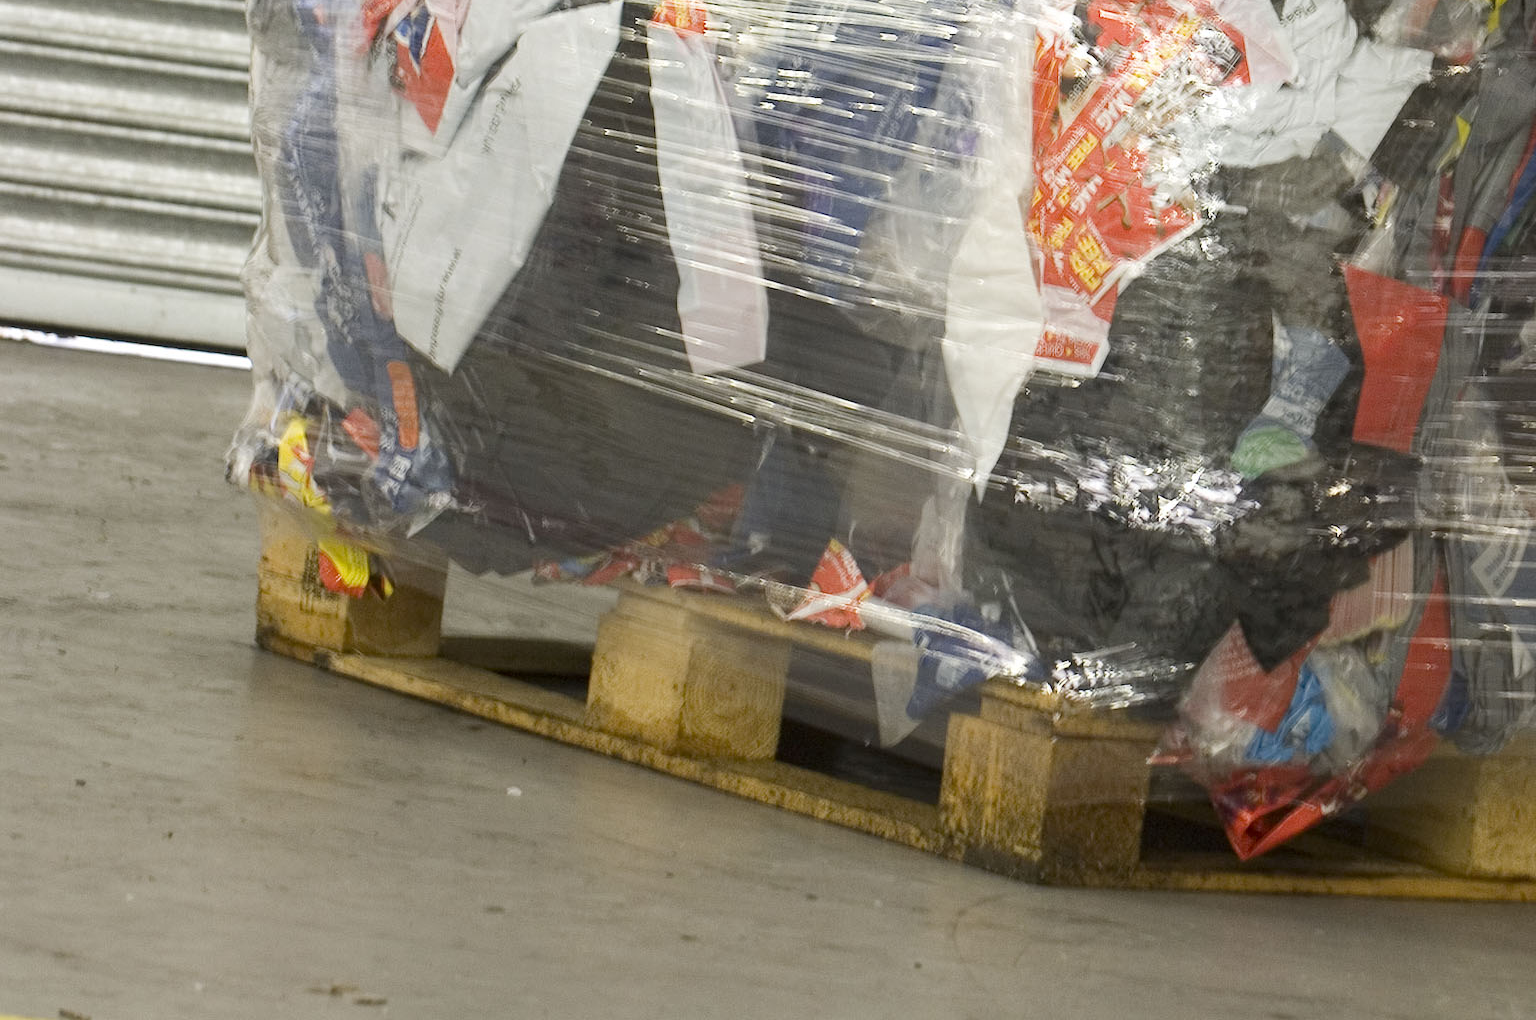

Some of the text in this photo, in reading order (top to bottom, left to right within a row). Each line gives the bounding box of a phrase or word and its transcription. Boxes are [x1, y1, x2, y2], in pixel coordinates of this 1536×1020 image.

[1094, 88, 1134, 133] MAG
[1064, 132, 1099, 170] FREE
[1071, 174, 1103, 215] MAG
